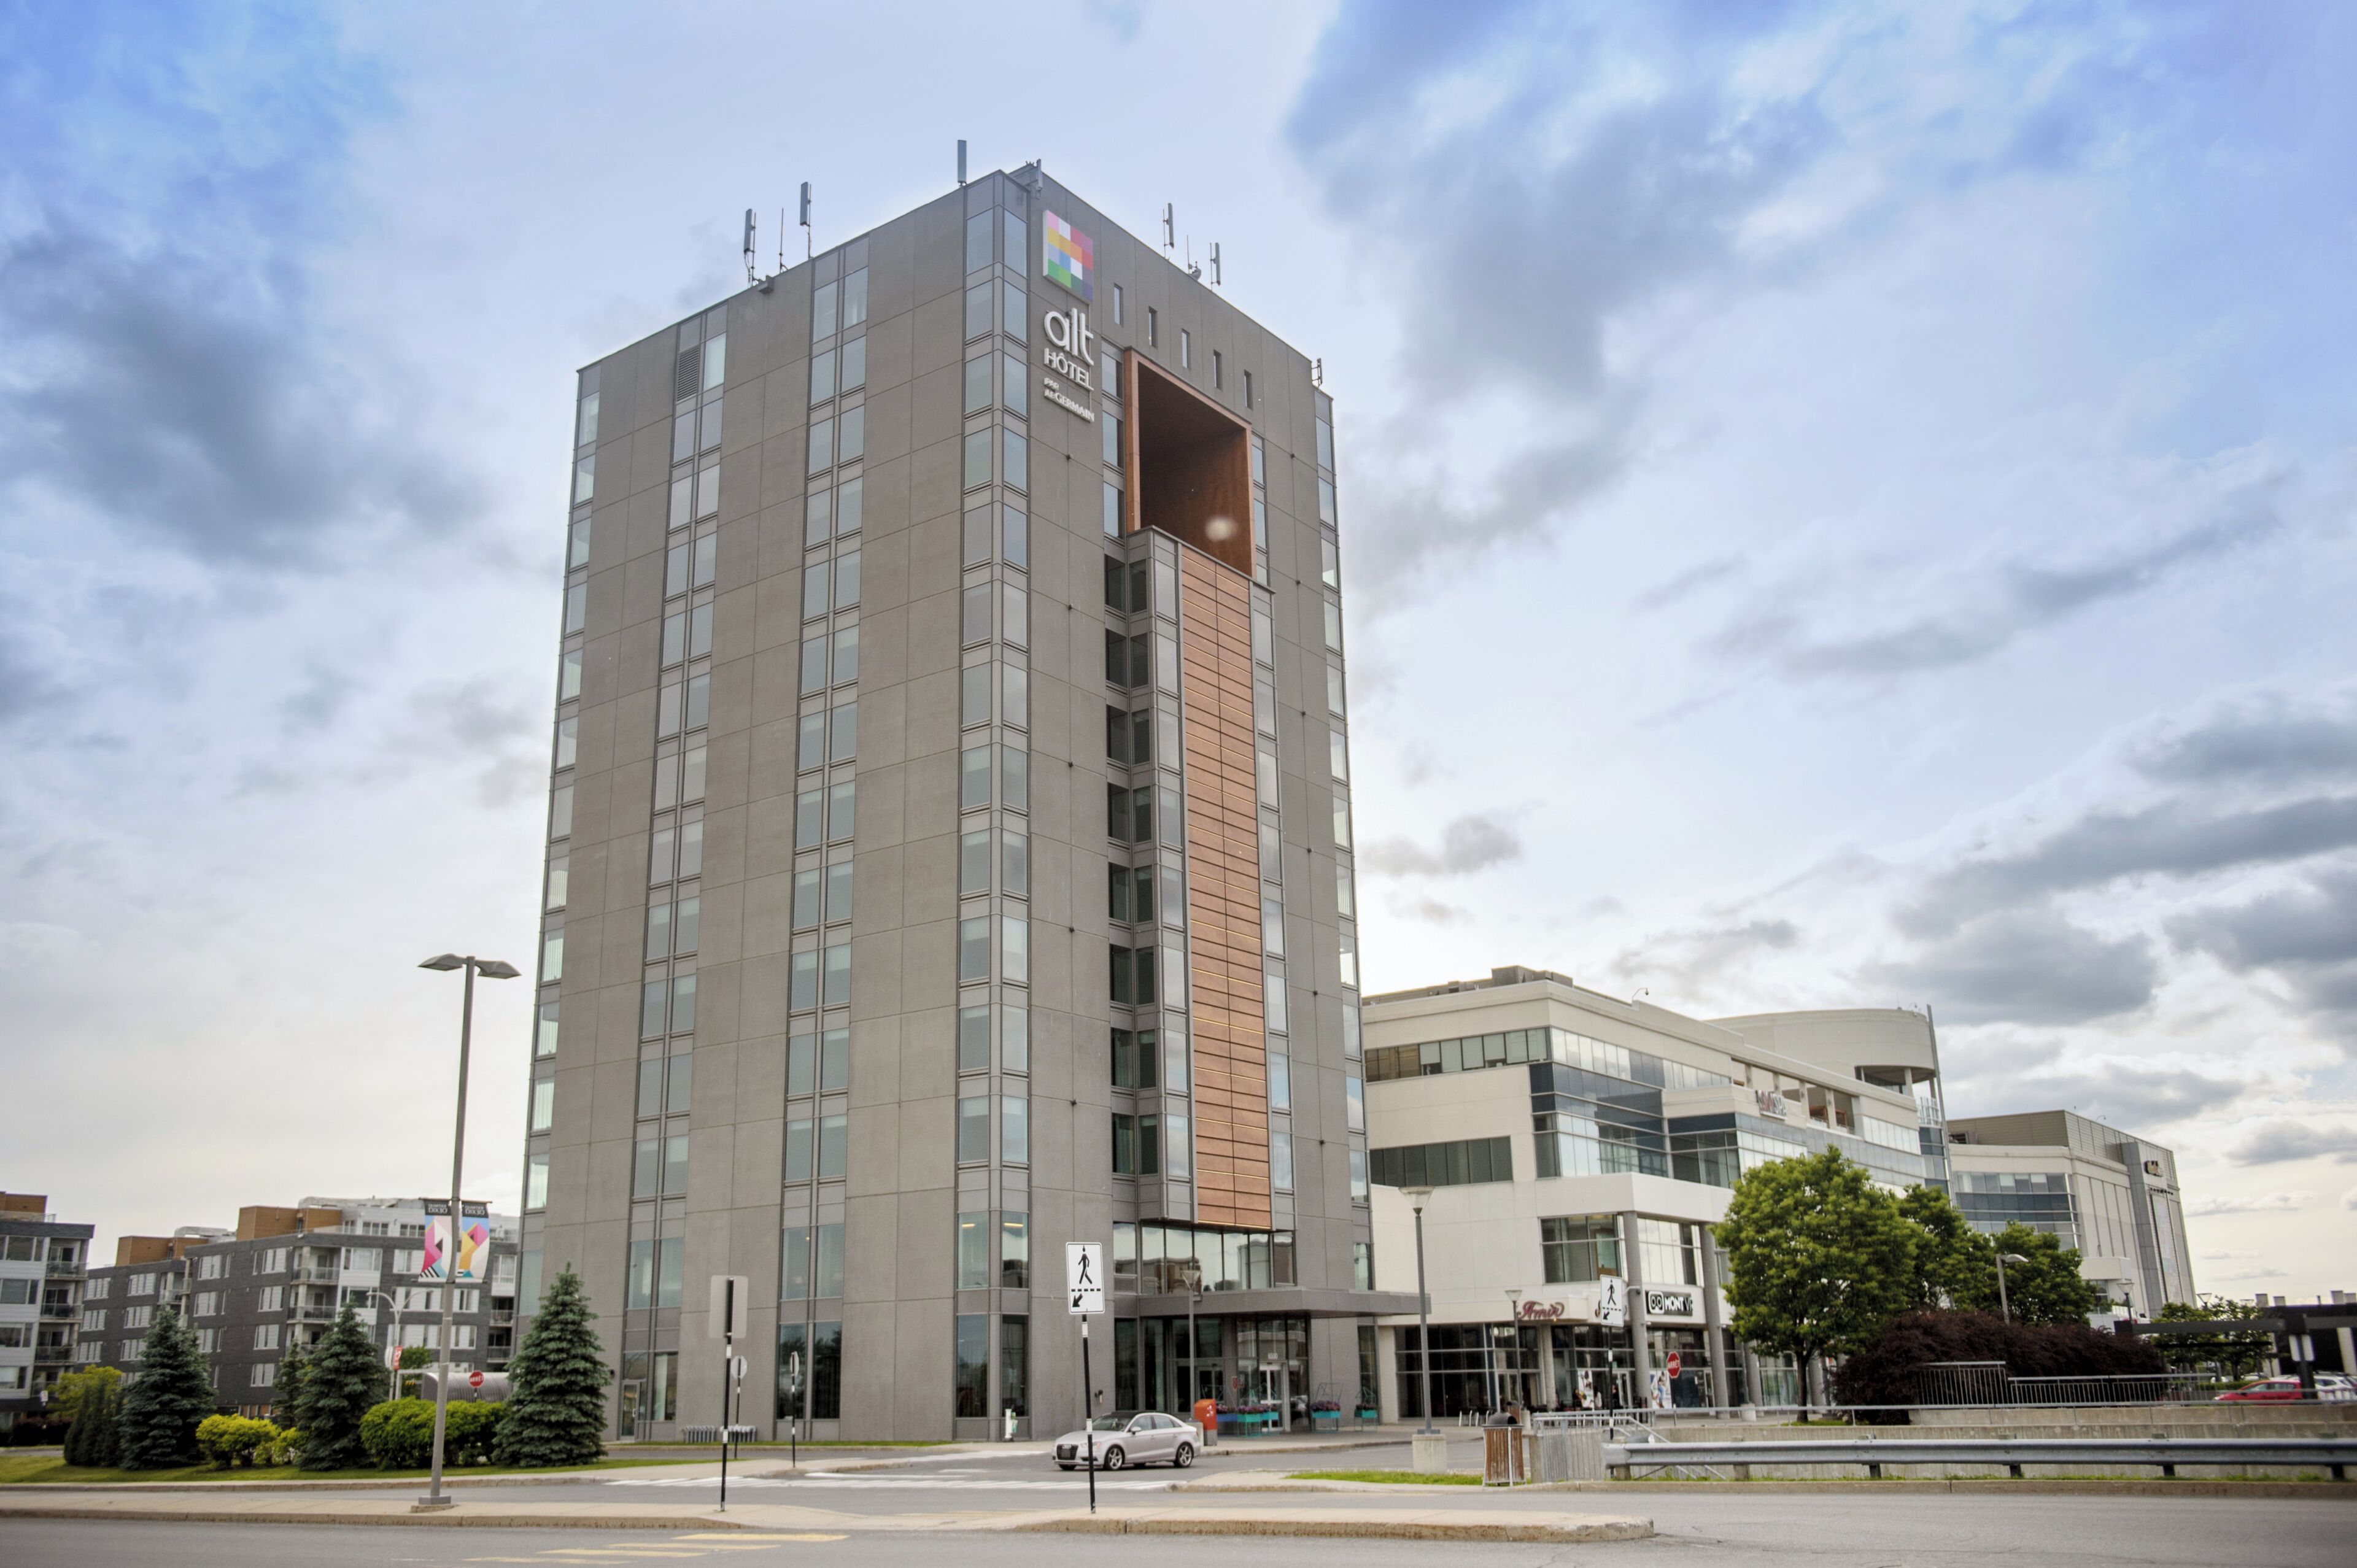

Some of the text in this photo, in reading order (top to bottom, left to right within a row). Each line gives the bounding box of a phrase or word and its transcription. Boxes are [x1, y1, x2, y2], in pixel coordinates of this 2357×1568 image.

[1044, 307, 1094, 366] alt
[1043, 347, 1094, 391] HÔTEL
[1056, 392, 1094, 422] GERMAIN
[1664, 1296, 1684, 1311] MONT
[1668, 1359, 1679, 1369] ARRÊT
